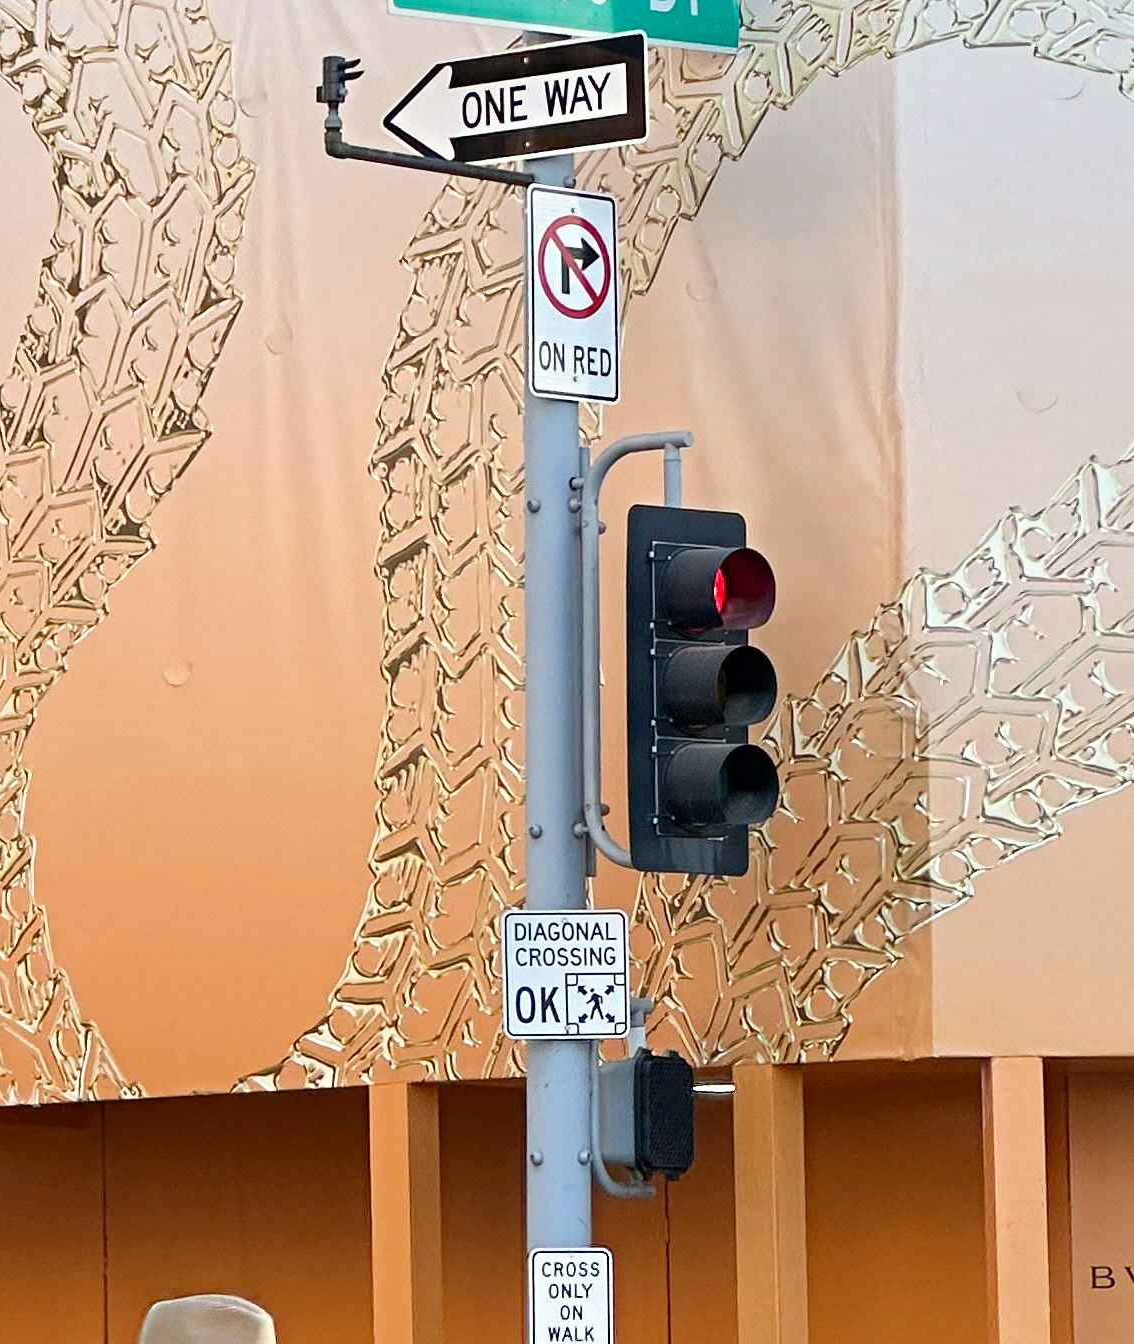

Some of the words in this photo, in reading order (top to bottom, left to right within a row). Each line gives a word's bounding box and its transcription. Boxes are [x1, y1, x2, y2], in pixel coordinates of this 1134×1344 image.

[462, 84, 528, 130] ONE
[544, 71, 611, 119] WAY
[539, 340, 566, 374] ON
[572, 343, 612, 378] RED
[514, 921, 617, 942] DIAGONAL
[515, 946, 616, 967] CROSSING
[515, 986, 561, 1024] OK
[541, 1261, 600, 1278] CROSS
[548, 1283, 593, 1299] ONLY
[560, 1305, 583, 1320] ON
[548, 1326, 594, 1342] WALK
